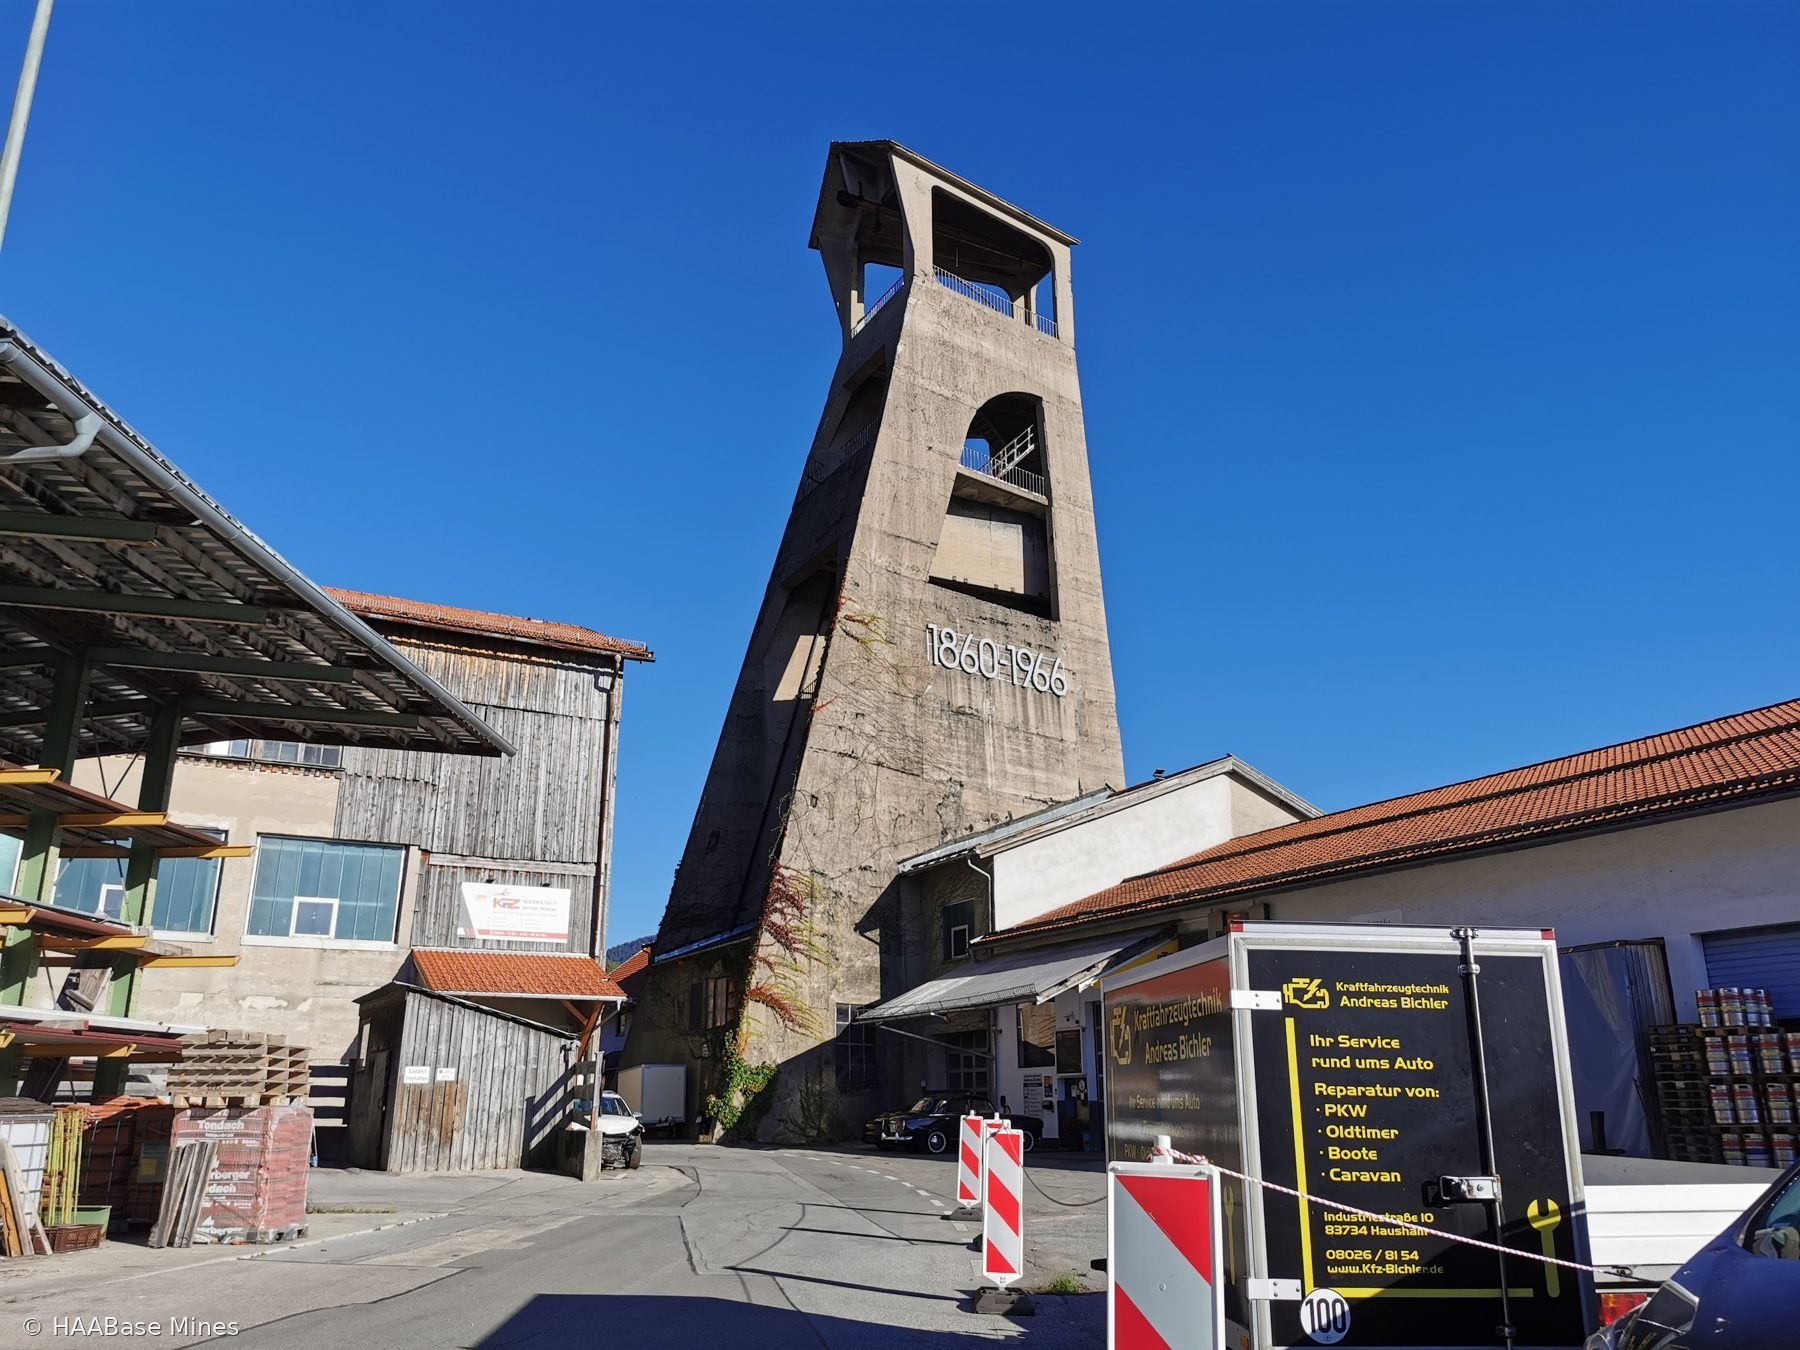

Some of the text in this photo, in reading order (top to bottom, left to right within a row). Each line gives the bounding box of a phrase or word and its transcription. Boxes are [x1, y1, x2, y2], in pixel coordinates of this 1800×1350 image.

[927, 624, 1067, 697] 1860-1966
[1336, 982, 1449, 994] Kraftfahrzeugtechnik
[1134, 988, 1223, 1031] Kraftfahrzeugtechnik
[1340, 996, 1448, 1009] Andreas Bichler
[1145, 1032, 1211, 1064] Andreas Bichler
[1309, 1034, 1400, 1049] Ihr Service
[1312, 1056, 1434, 1070] rund ums Auto
[1315, 1082, 1440, 1099] Reparatur von:
[1137, 1094, 1155, 1108] Service
[1185, 1093, 1200, 1110] Auto
[1324, 1104, 1367, 1117] PKW
[197, 1120, 244, 1130] Tondach
[1326, 1125, 1399, 1139] Oldtimer
[1328, 1146, 1378, 1160] Boote
[209, 1171, 250, 1180] rberger
[1330, 1168, 1402, 1182] Caravan
[1421, 1213, 1434, 1222] 10
[1325, 1225, 1368, 1236] 83734
[1326, 1250, 1372, 1260] 08026
[1375, 1250, 1382, 1261] /
[1400, 1251, 1419, 1261] 54
[1327, 1264, 1444, 1275] www.Kfz-Bichler.de
[1305, 1298, 1347, 1334] 100
